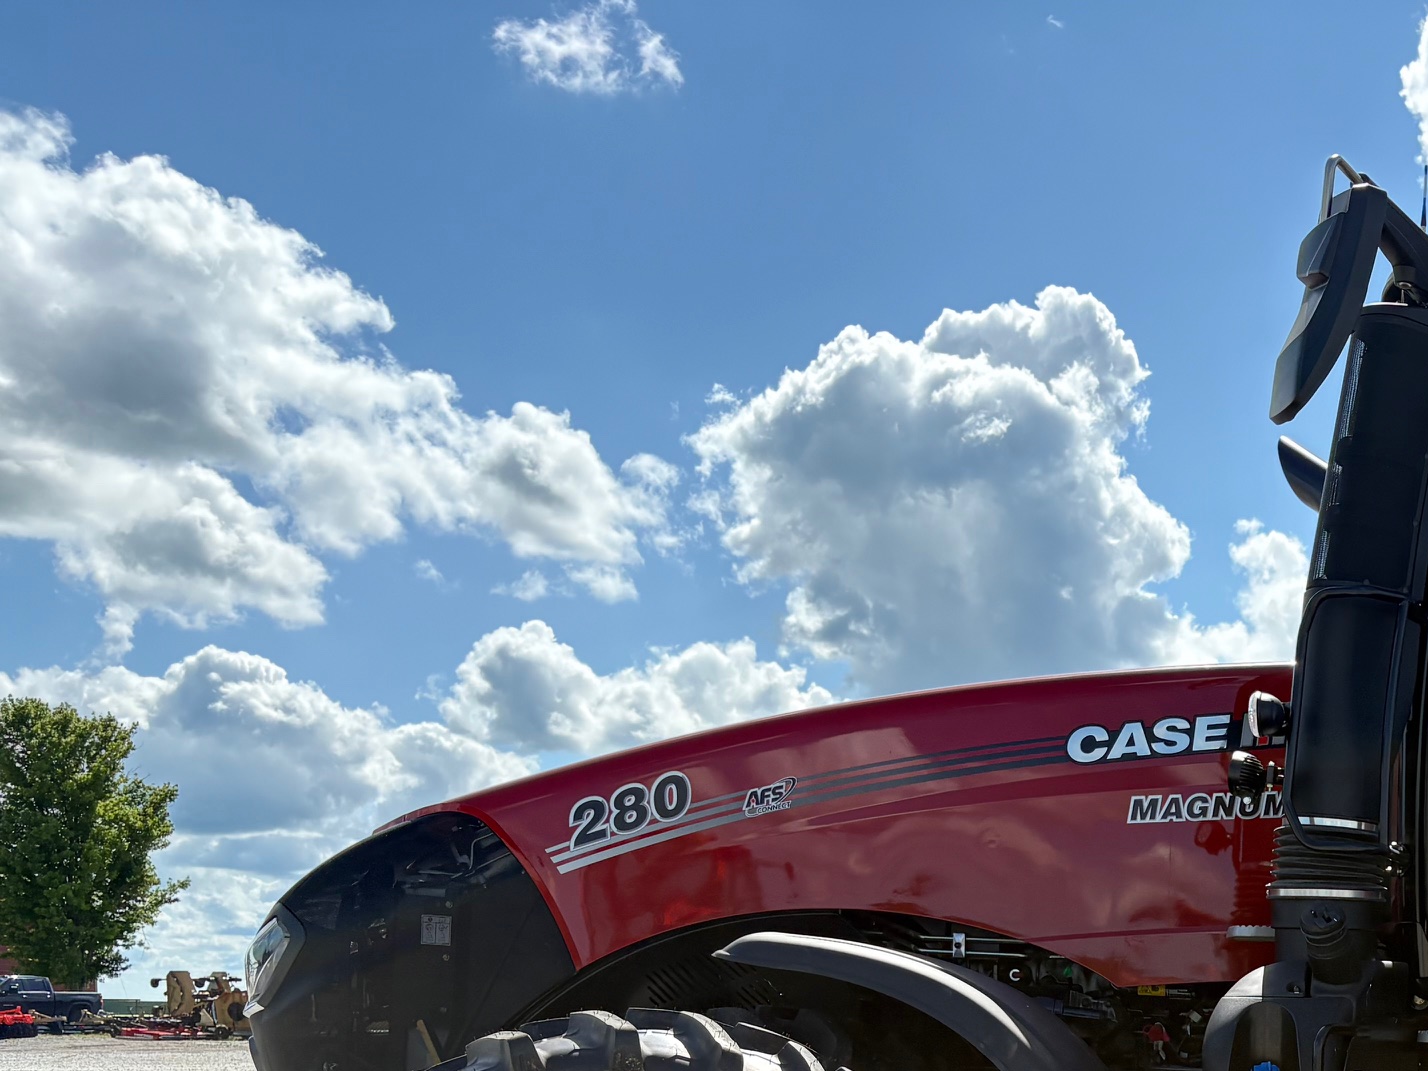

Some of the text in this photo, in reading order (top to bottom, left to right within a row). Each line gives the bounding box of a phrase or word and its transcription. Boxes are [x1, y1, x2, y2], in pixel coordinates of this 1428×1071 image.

[1067, 715, 1230, 763] CASE
[569, 771, 692, 852] 280
[743, 781, 786, 811] AFS
[757, 800, 792, 815] CONNECT
[1127, 791, 1287, 824] MAGNUM
